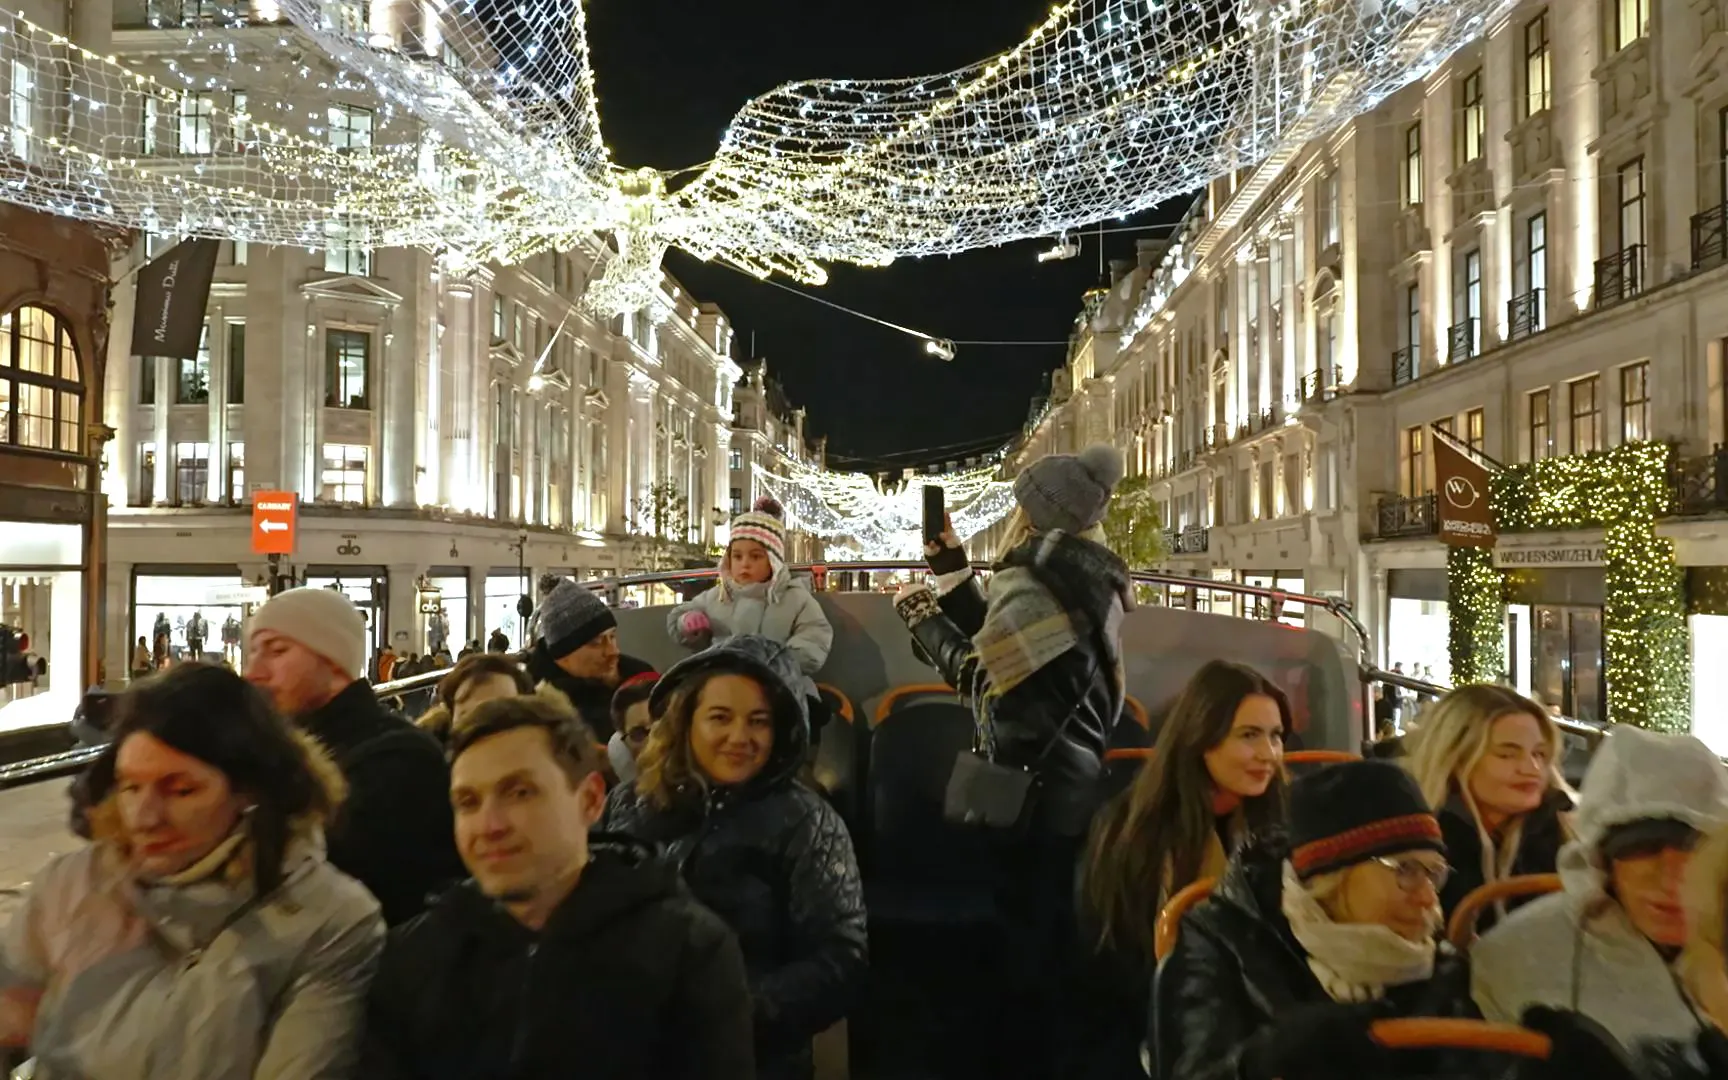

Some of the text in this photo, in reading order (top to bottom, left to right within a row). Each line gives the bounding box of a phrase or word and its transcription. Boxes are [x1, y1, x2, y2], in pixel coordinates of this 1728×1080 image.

[1448, 480, 1466, 494] W
[336, 539, 361, 556] alo
[421, 599, 440, 613] alo
